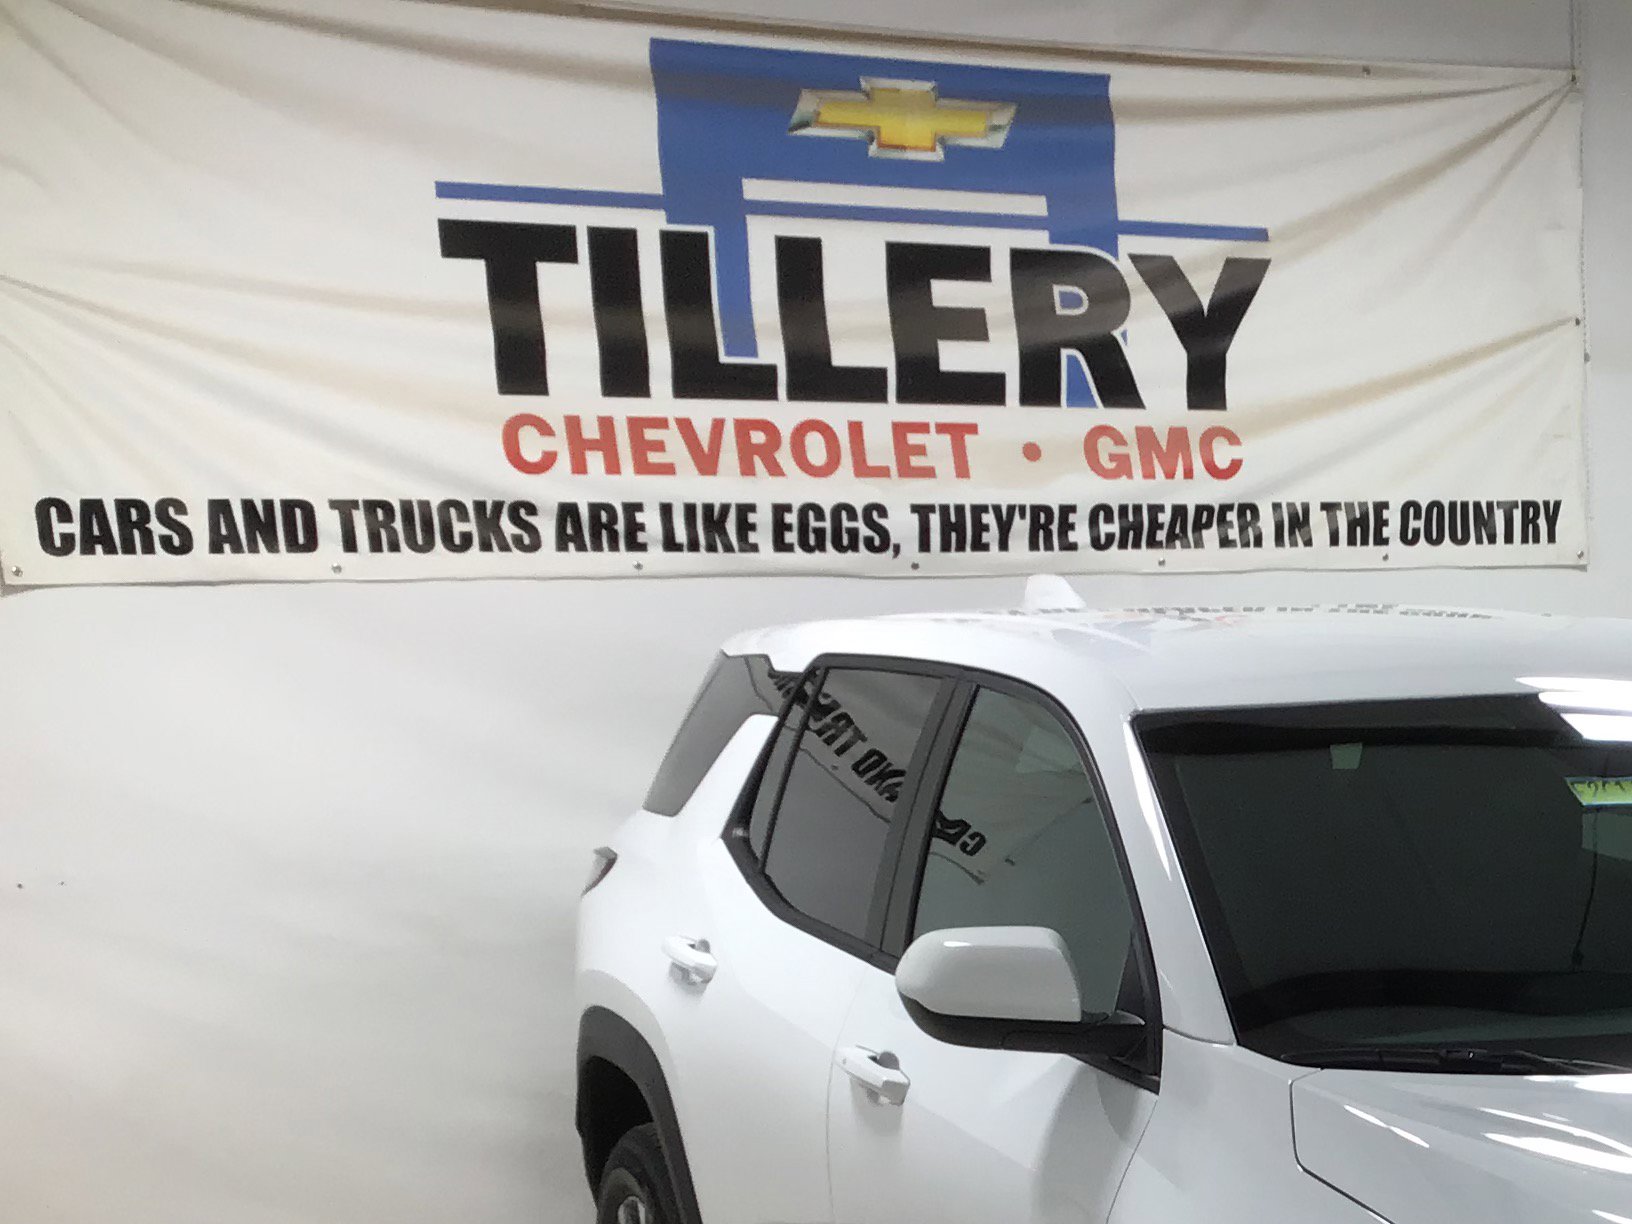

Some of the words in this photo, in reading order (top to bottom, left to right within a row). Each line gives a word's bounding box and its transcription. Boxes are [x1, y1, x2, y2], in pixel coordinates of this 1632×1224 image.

[438, 218, 1272, 412] TILLERY
[502, 413, 979, 480] CHEVROLET
[1083, 425, 1243, 480] GMC
[35, 498, 194, 556] CARS
[208, 499, 319, 555] AND
[330, 499, 541, 554] TRUCKS
[556, 502, 647, 553] ARE
[660, 502, 759, 553] LIKE
[771, 503, 901, 559] EGGS,
[911, 503, 1078, 553] THEY'RE
[1089, 503, 1263, 551] CHEAPER
[1272, 502, 1313, 548] IN
[1320, 502, 1390, 547] THE
[1399, 500, 1562, 547] COUNTRY
